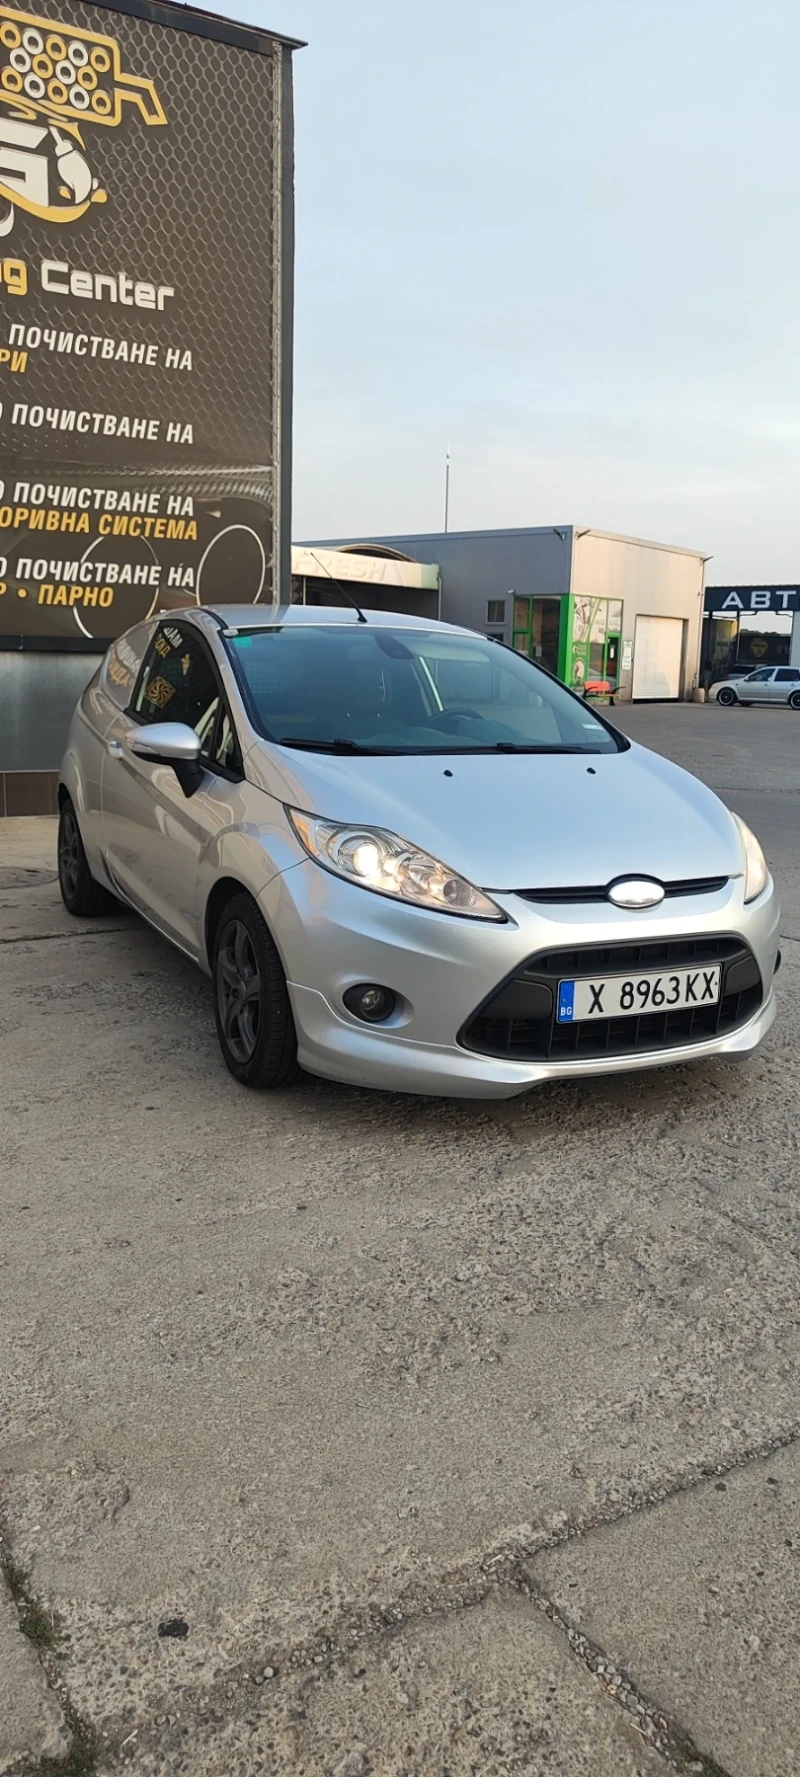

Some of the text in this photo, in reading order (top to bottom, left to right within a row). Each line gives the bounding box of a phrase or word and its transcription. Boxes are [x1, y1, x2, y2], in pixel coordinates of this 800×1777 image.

[0, 257, 175, 311] g Center
[8, 323, 193, 371] ПОЧИСТВАНЕ НА
[11, 403, 160, 441] ПОЧИСТВАНЕ
[166, 422, 194, 445] НА
[13, 481, 160, 515] ПОЧИСТВАНЕ
[166, 495, 194, 517] НА
[98, 513, 198, 541] СИСТЕМА
[15, 557, 161, 586] ПОЧИСТВАНЕ
[167, 566, 195, 589] НА
[294, 555, 387, 581] FRESH
[37, 583, 114, 608] ПАРНО
[560, 1006, 573, 1017] BG
[588, 983, 604, 1014] X
